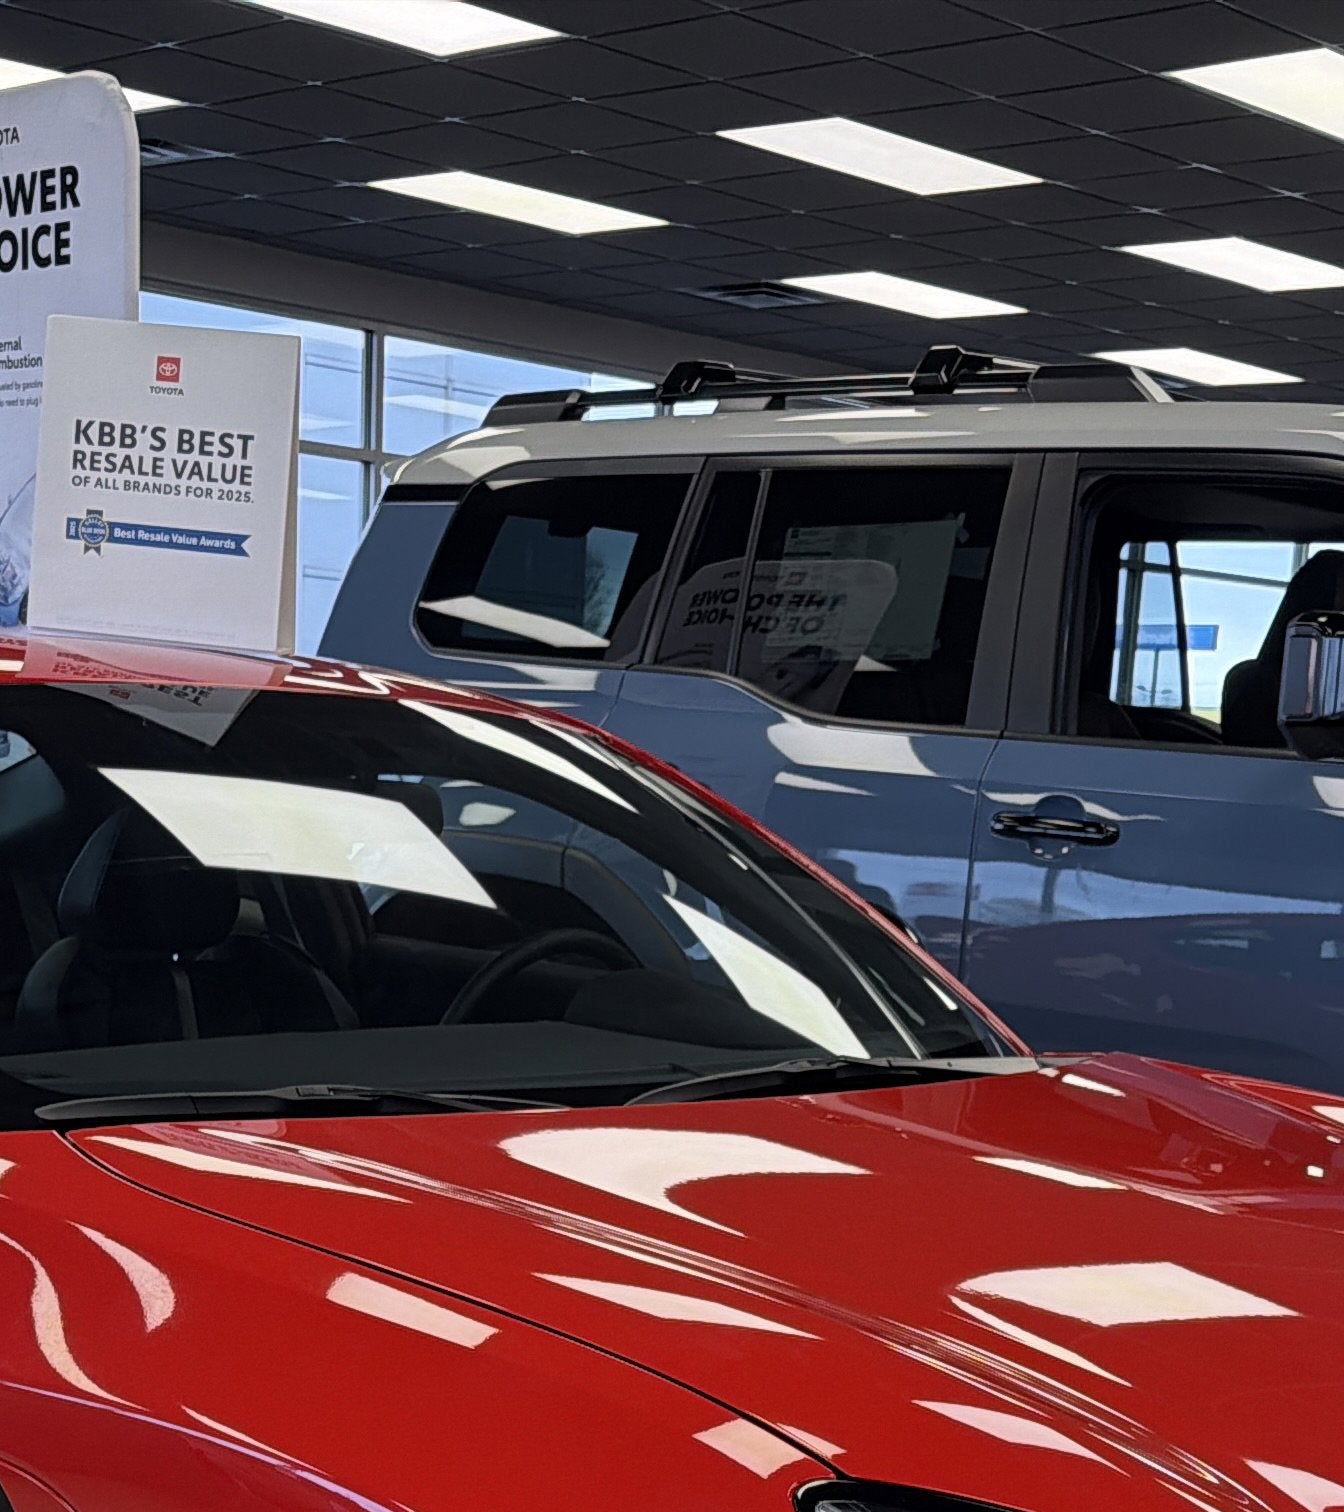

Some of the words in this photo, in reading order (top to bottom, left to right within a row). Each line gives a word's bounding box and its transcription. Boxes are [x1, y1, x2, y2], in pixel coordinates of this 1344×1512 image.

[149, 386, 184, 396] TOYOTA
[74, 418, 167, 452] KBB'S
[177, 428, 255, 460] BEST
[72, 450, 165, 478] RESALE
[171, 458, 253, 486] VALUE
[71, 475, 91, 488] OF
[94, 477, 119, 491] ALL
[123, 480, 181, 497] BRANDS
[185, 486, 214, 500] FOR
[217, 488, 254, 504] 2025.
[113, 527, 135, 539] Best
[137, 530, 170, 543] Resale
[171, 533, 198, 546] Value
[199, 536, 236, 550] Awards
